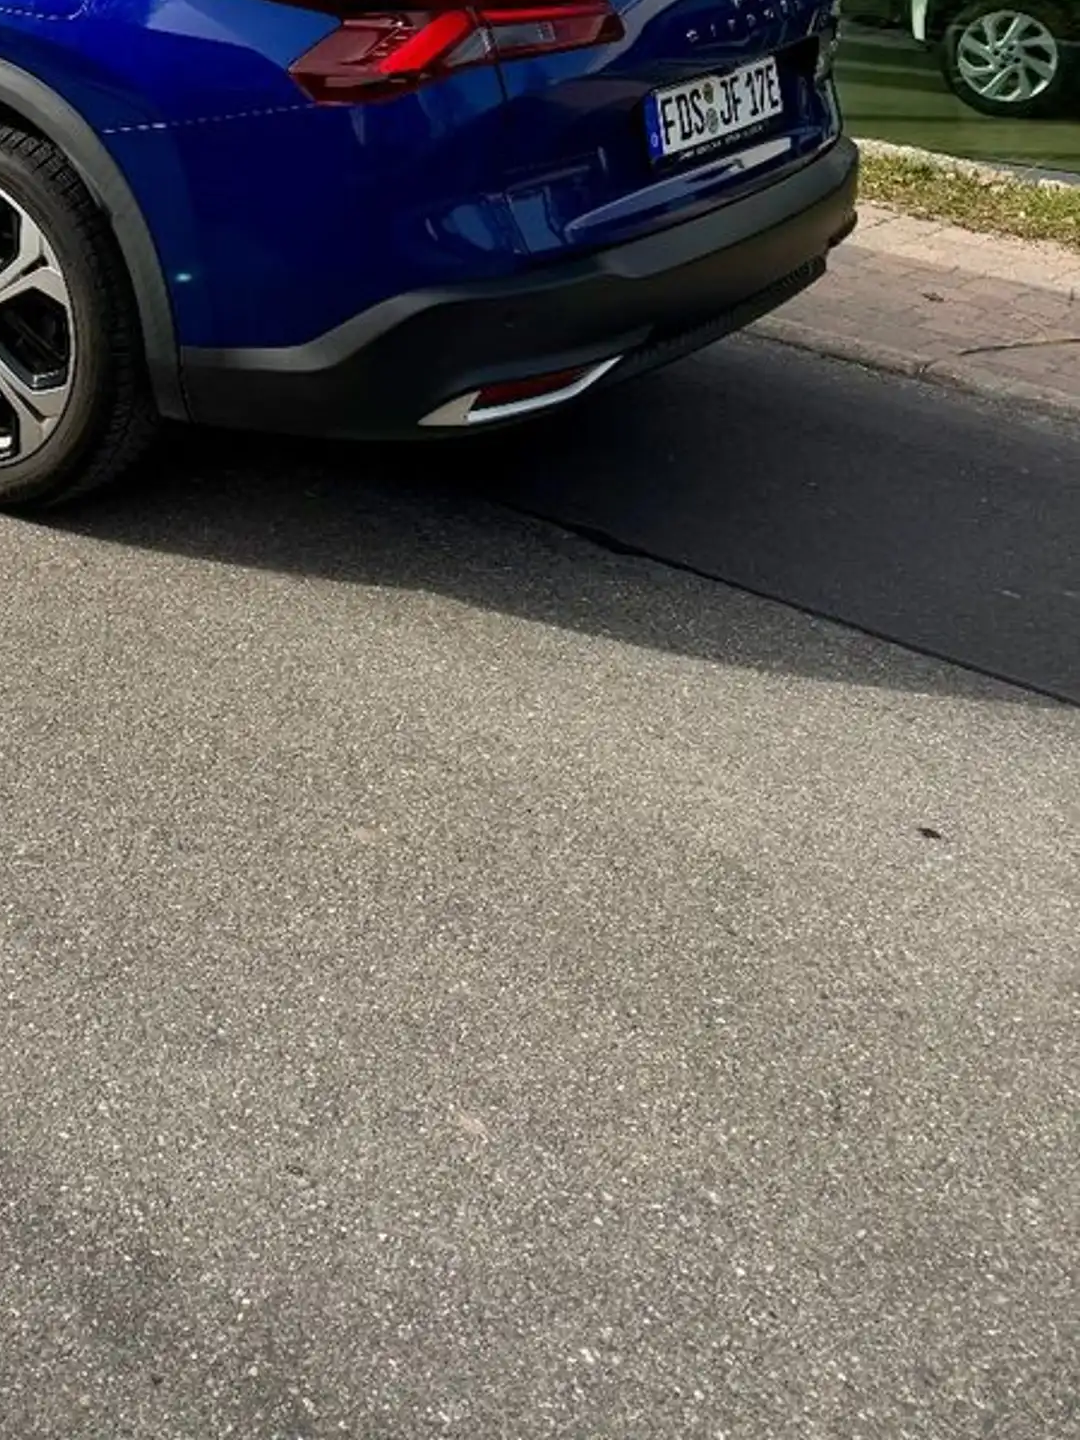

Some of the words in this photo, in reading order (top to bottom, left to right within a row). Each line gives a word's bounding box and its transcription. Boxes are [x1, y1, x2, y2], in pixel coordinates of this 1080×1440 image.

[661, 89, 705, 145] FDS
[720, 77, 742, 125] JF
[745, 64, 779, 116] 17E
